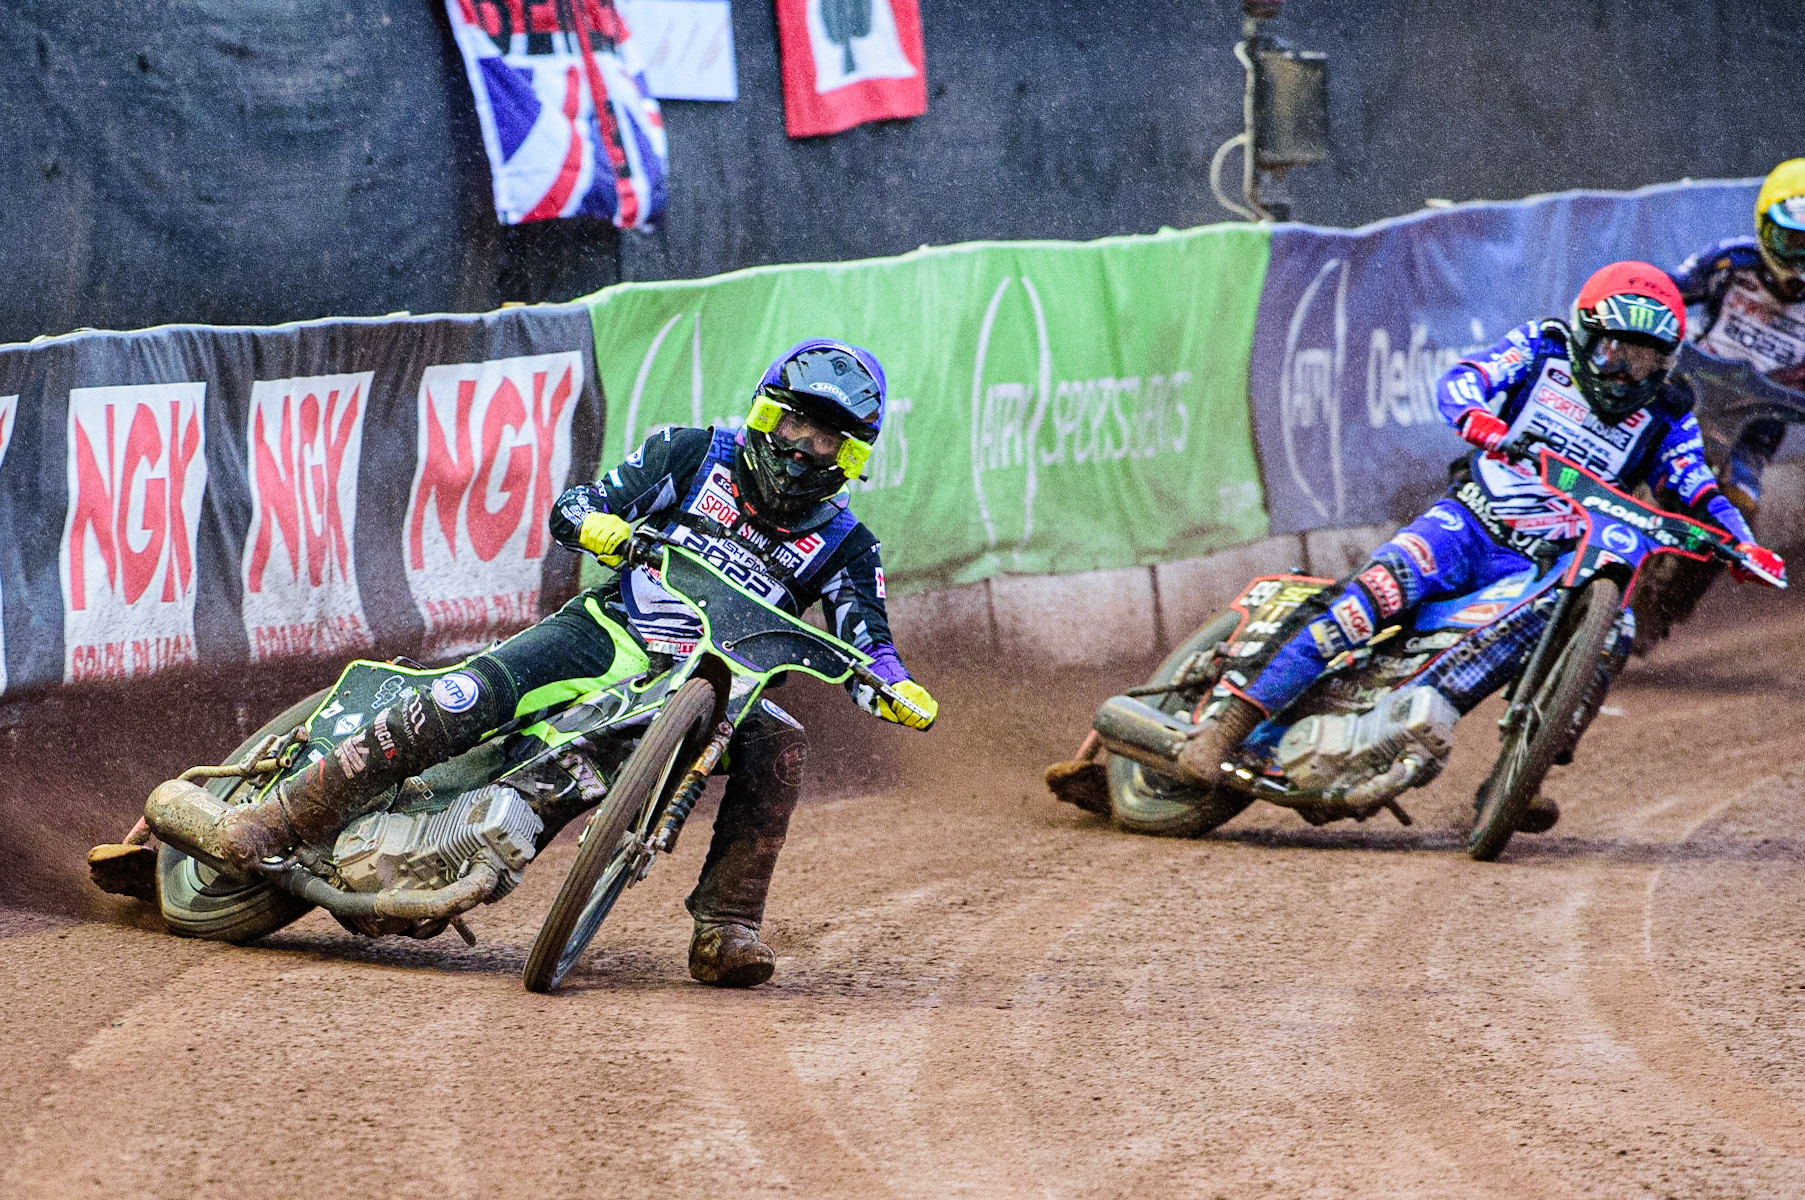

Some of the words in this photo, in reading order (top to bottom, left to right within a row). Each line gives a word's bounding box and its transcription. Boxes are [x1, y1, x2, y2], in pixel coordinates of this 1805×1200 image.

[1537, 387, 1588, 423] SPORTS
[248, 381, 363, 593] NGK
[409, 364, 573, 571] NGK
[70, 400, 199, 611] NGK
[701, 495, 751, 539] SPORS
[682, 535, 772, 598] 2022
[1342, 602, 1371, 636] NGK
[444, 679, 467, 704] ATPI
